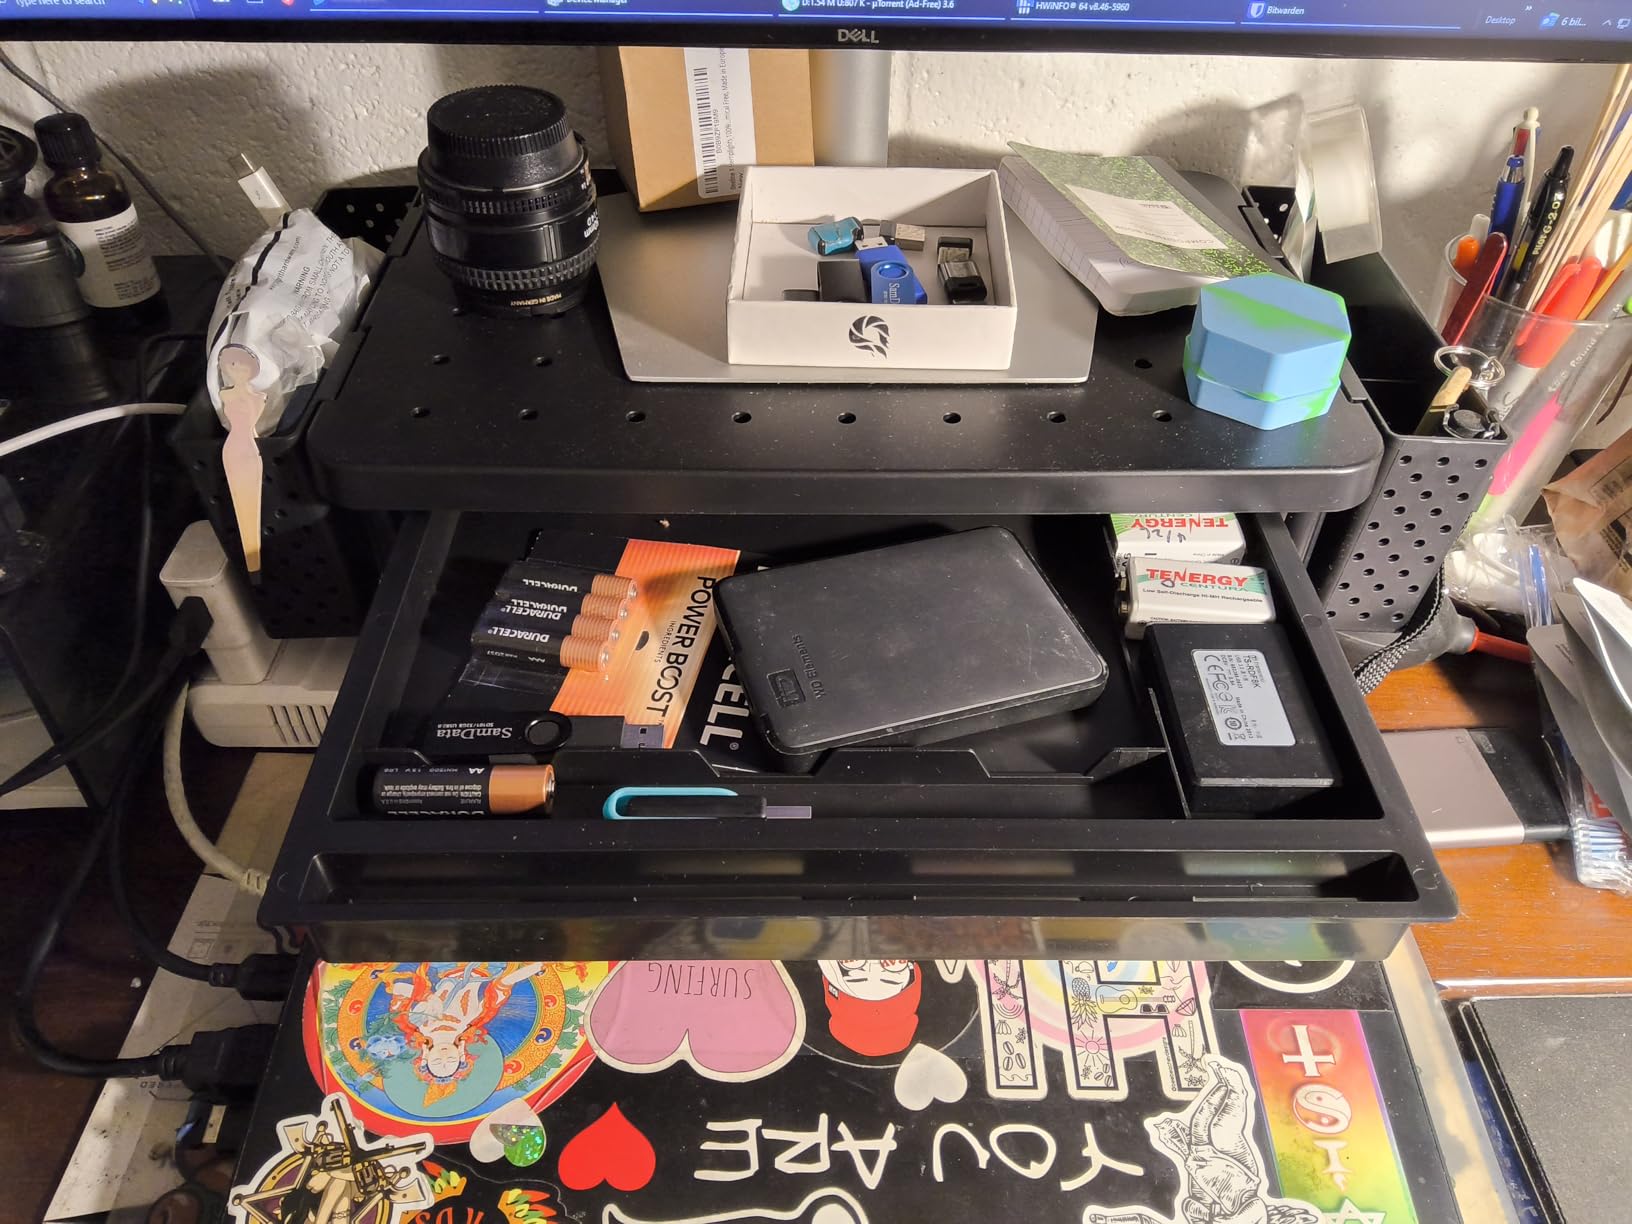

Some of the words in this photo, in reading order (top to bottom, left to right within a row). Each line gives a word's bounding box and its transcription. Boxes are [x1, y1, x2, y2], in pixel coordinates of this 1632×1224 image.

[1266, 5, 1305, 16] Bitwarden
[1485, 16, 1516, 26] Desktop
[837, 29, 880, 44] DELL
[719, 48, 727, 68] Europ
[720, 75, 729, 91] Made
[1532, 235, 1548, 256] PILOT
[888, 282, 901, 305] SamD
[1131, 514, 1229, 533] TENERGY
[1146, 568, 1248, 587] TENERGY
[1220, 595, 1263, 604] Rechargeable
[674, 576, 717, 648] POWER
[654, 620, 677, 664] INGREDIENTS
[791, 632, 818, 679] Elements
[646, 652, 689, 718] BOOST
[810, 679, 827, 700] WD
[436, 726, 513, 740] SamData
[468, 767, 486, 775] AA
[647, 961, 756, 1000] SURFING
[693, 1112, 898, 1191] ARE
[932, 1121, 1145, 1192] YOU
